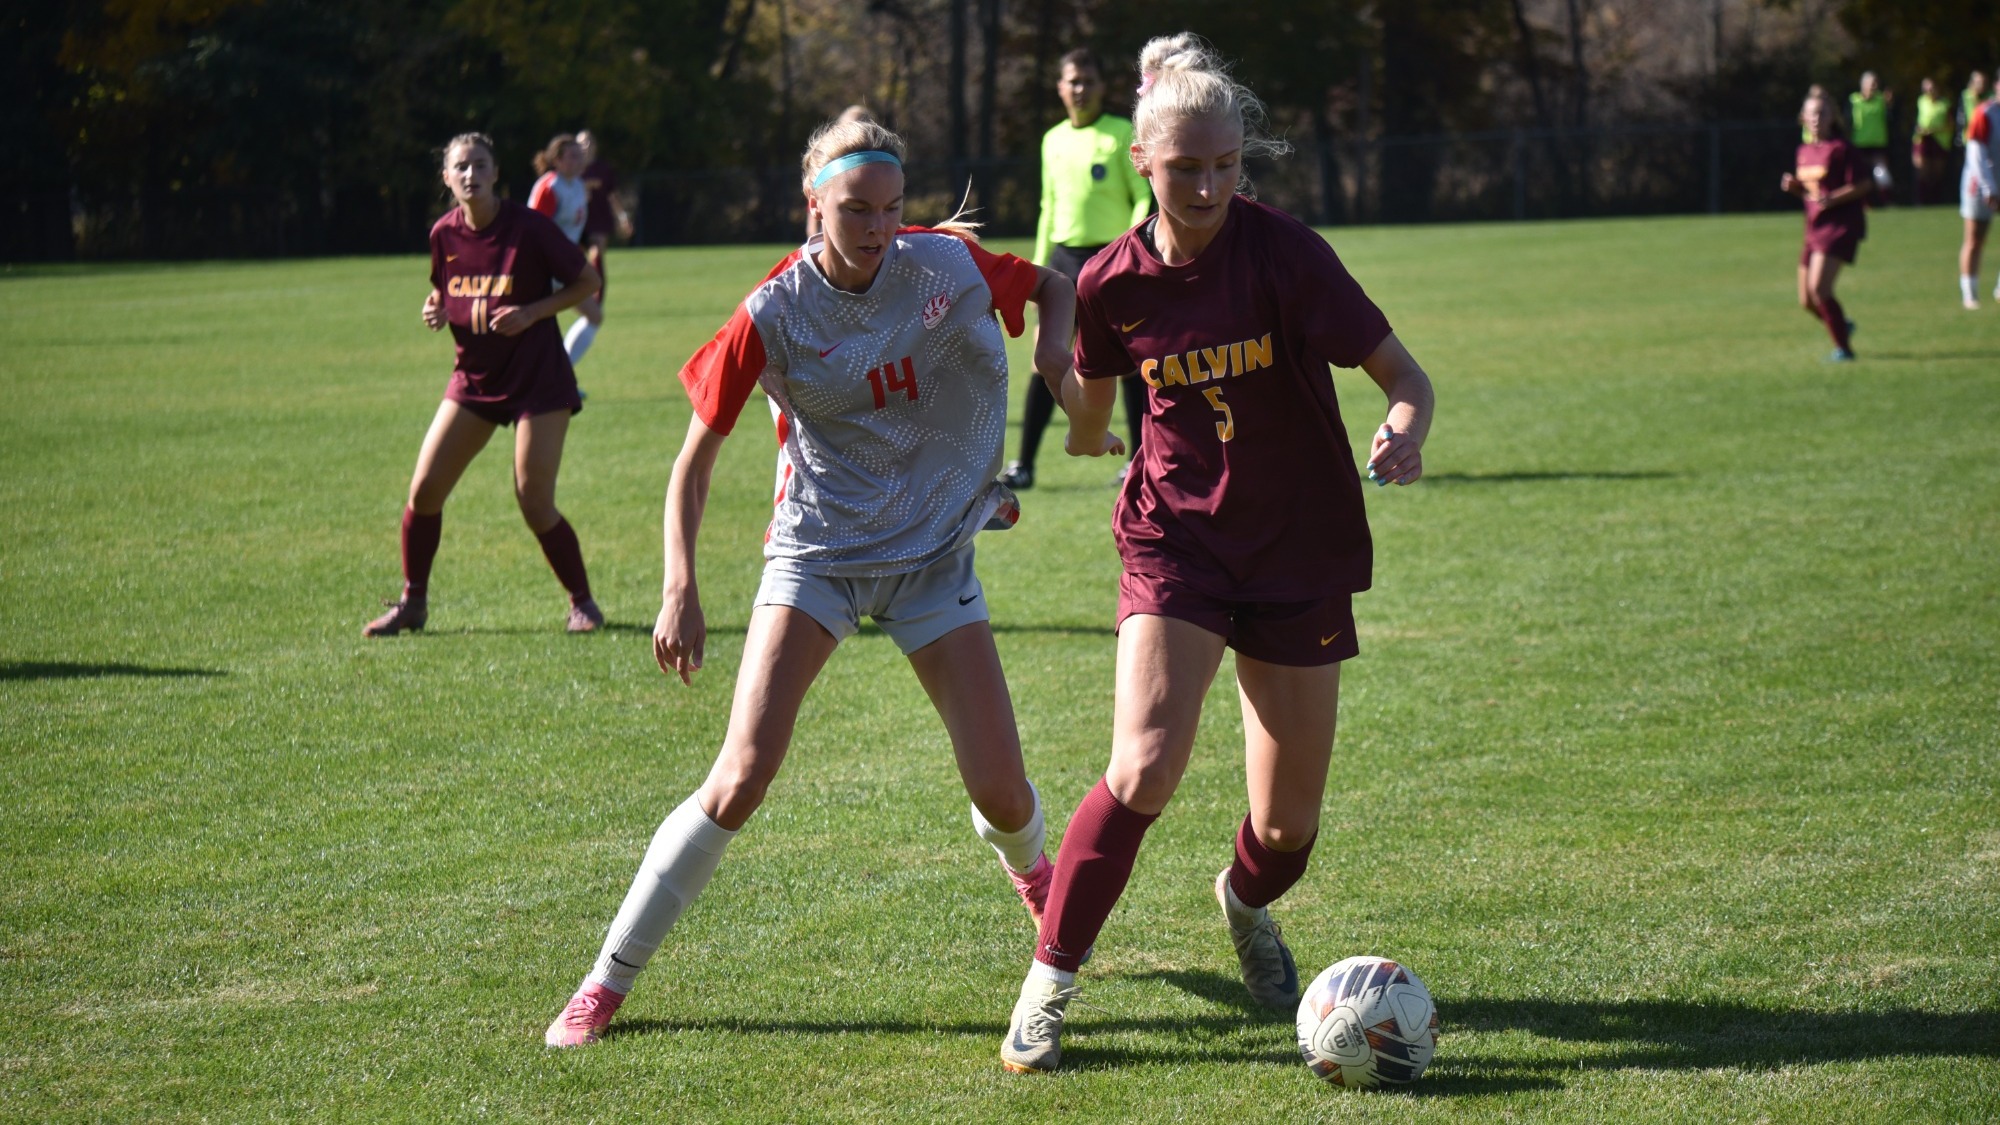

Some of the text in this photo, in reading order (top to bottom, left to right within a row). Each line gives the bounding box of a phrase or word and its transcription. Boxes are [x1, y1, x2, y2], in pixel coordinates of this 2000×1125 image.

[447, 274, 513, 297] CALVIN
[471, 298, 487, 334] 11
[866, 355, 919, 410] 14
[1141, 332, 1273, 390] CALVIN
[1202, 386, 1234, 442] 5
